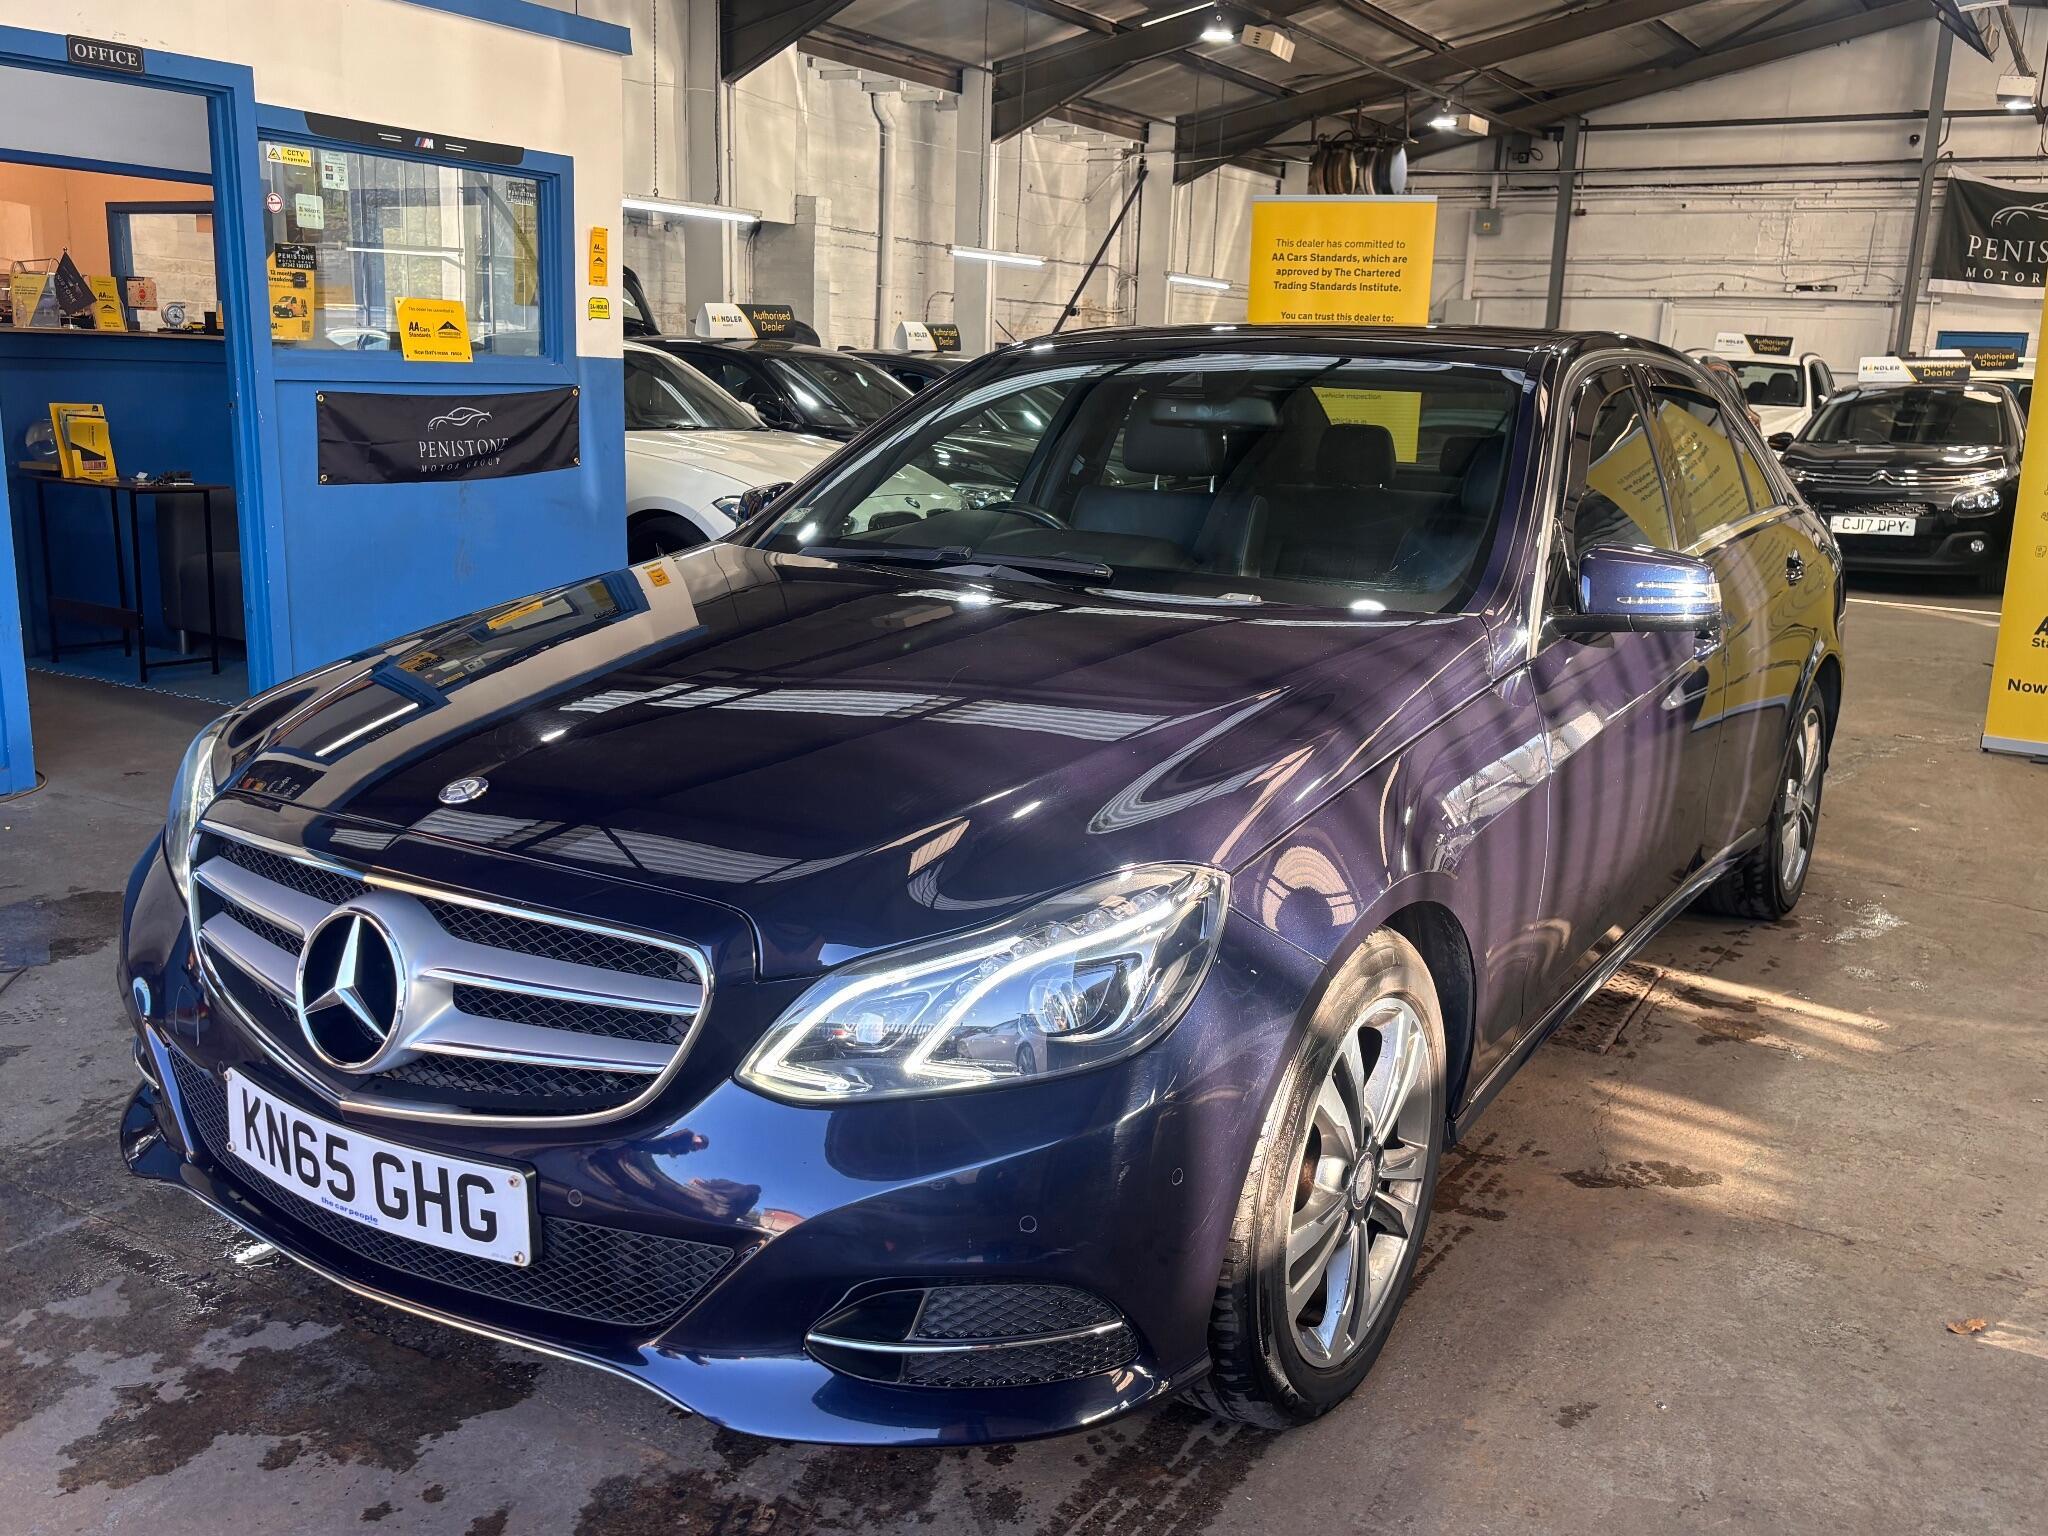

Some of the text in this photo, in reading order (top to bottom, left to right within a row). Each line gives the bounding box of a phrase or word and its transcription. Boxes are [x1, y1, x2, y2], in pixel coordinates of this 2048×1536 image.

[74, 43, 138, 67] OFFICE
[287, 149, 305, 157] CCTV
[1275, 238, 1406, 249] This dealer has committed to
[1272, 253, 1285, 261] AA
[1287, 253, 1308, 262] Cars
[1310, 253, 1360, 263] Standards,
[1362, 254, 1391, 263] which
[1275, 268, 1401, 278] approved by The Chartered
[1965, 267, 2041, 284] MOTOR
[1273, 281, 1402, 292] Trading Standards Institute.
[753, 310, 791, 320] Authorised
[1281, 312, 1394, 322] You can trust this dealer to:
[409, 321, 420, 331] AA
[761, 322, 785, 331] Dealer
[1753, 338, 1789, 346] Authorised
[1758, 344, 1781, 352] Dealer
[1915, 360, 1966, 369] Authorised
[1923, 369, 1956, 377] Dealer
[420, 457, 501, 473] MOTOR GROUP
[1842, 518, 1907, 533] CJ17 DPY
[2007, 678, 2048, 695] Now
[241, 1086, 499, 1244] KN65 GHG
[321, 1196, 334, 1207] the
